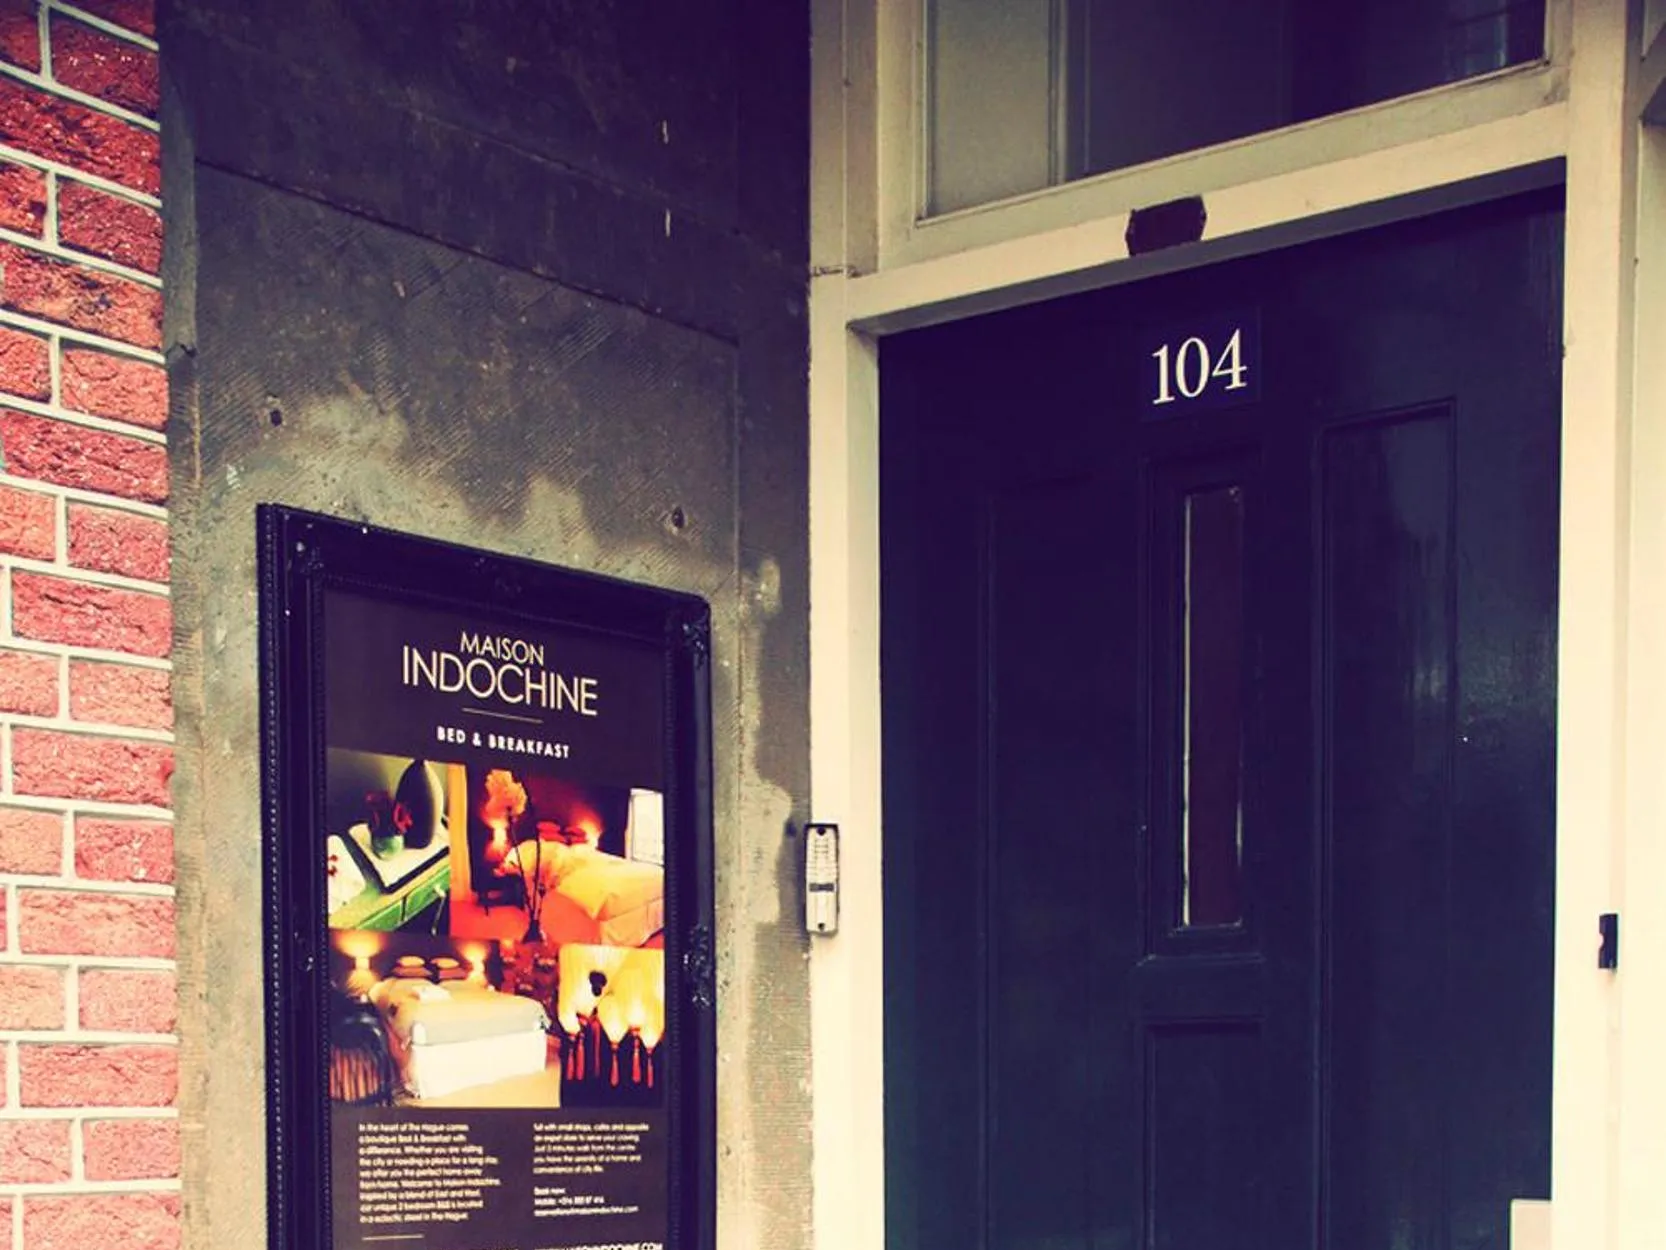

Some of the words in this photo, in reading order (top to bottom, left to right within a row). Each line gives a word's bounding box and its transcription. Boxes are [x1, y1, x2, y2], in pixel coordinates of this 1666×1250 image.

[1152, 327, 1248, 405] 104
[459, 630, 545, 666] MAISON
[402, 644, 599, 717] INDOCHINE
[435, 724, 467, 744] BED
[471, 731, 482, 747] &
[487, 733, 570, 760] BREAKFAST
